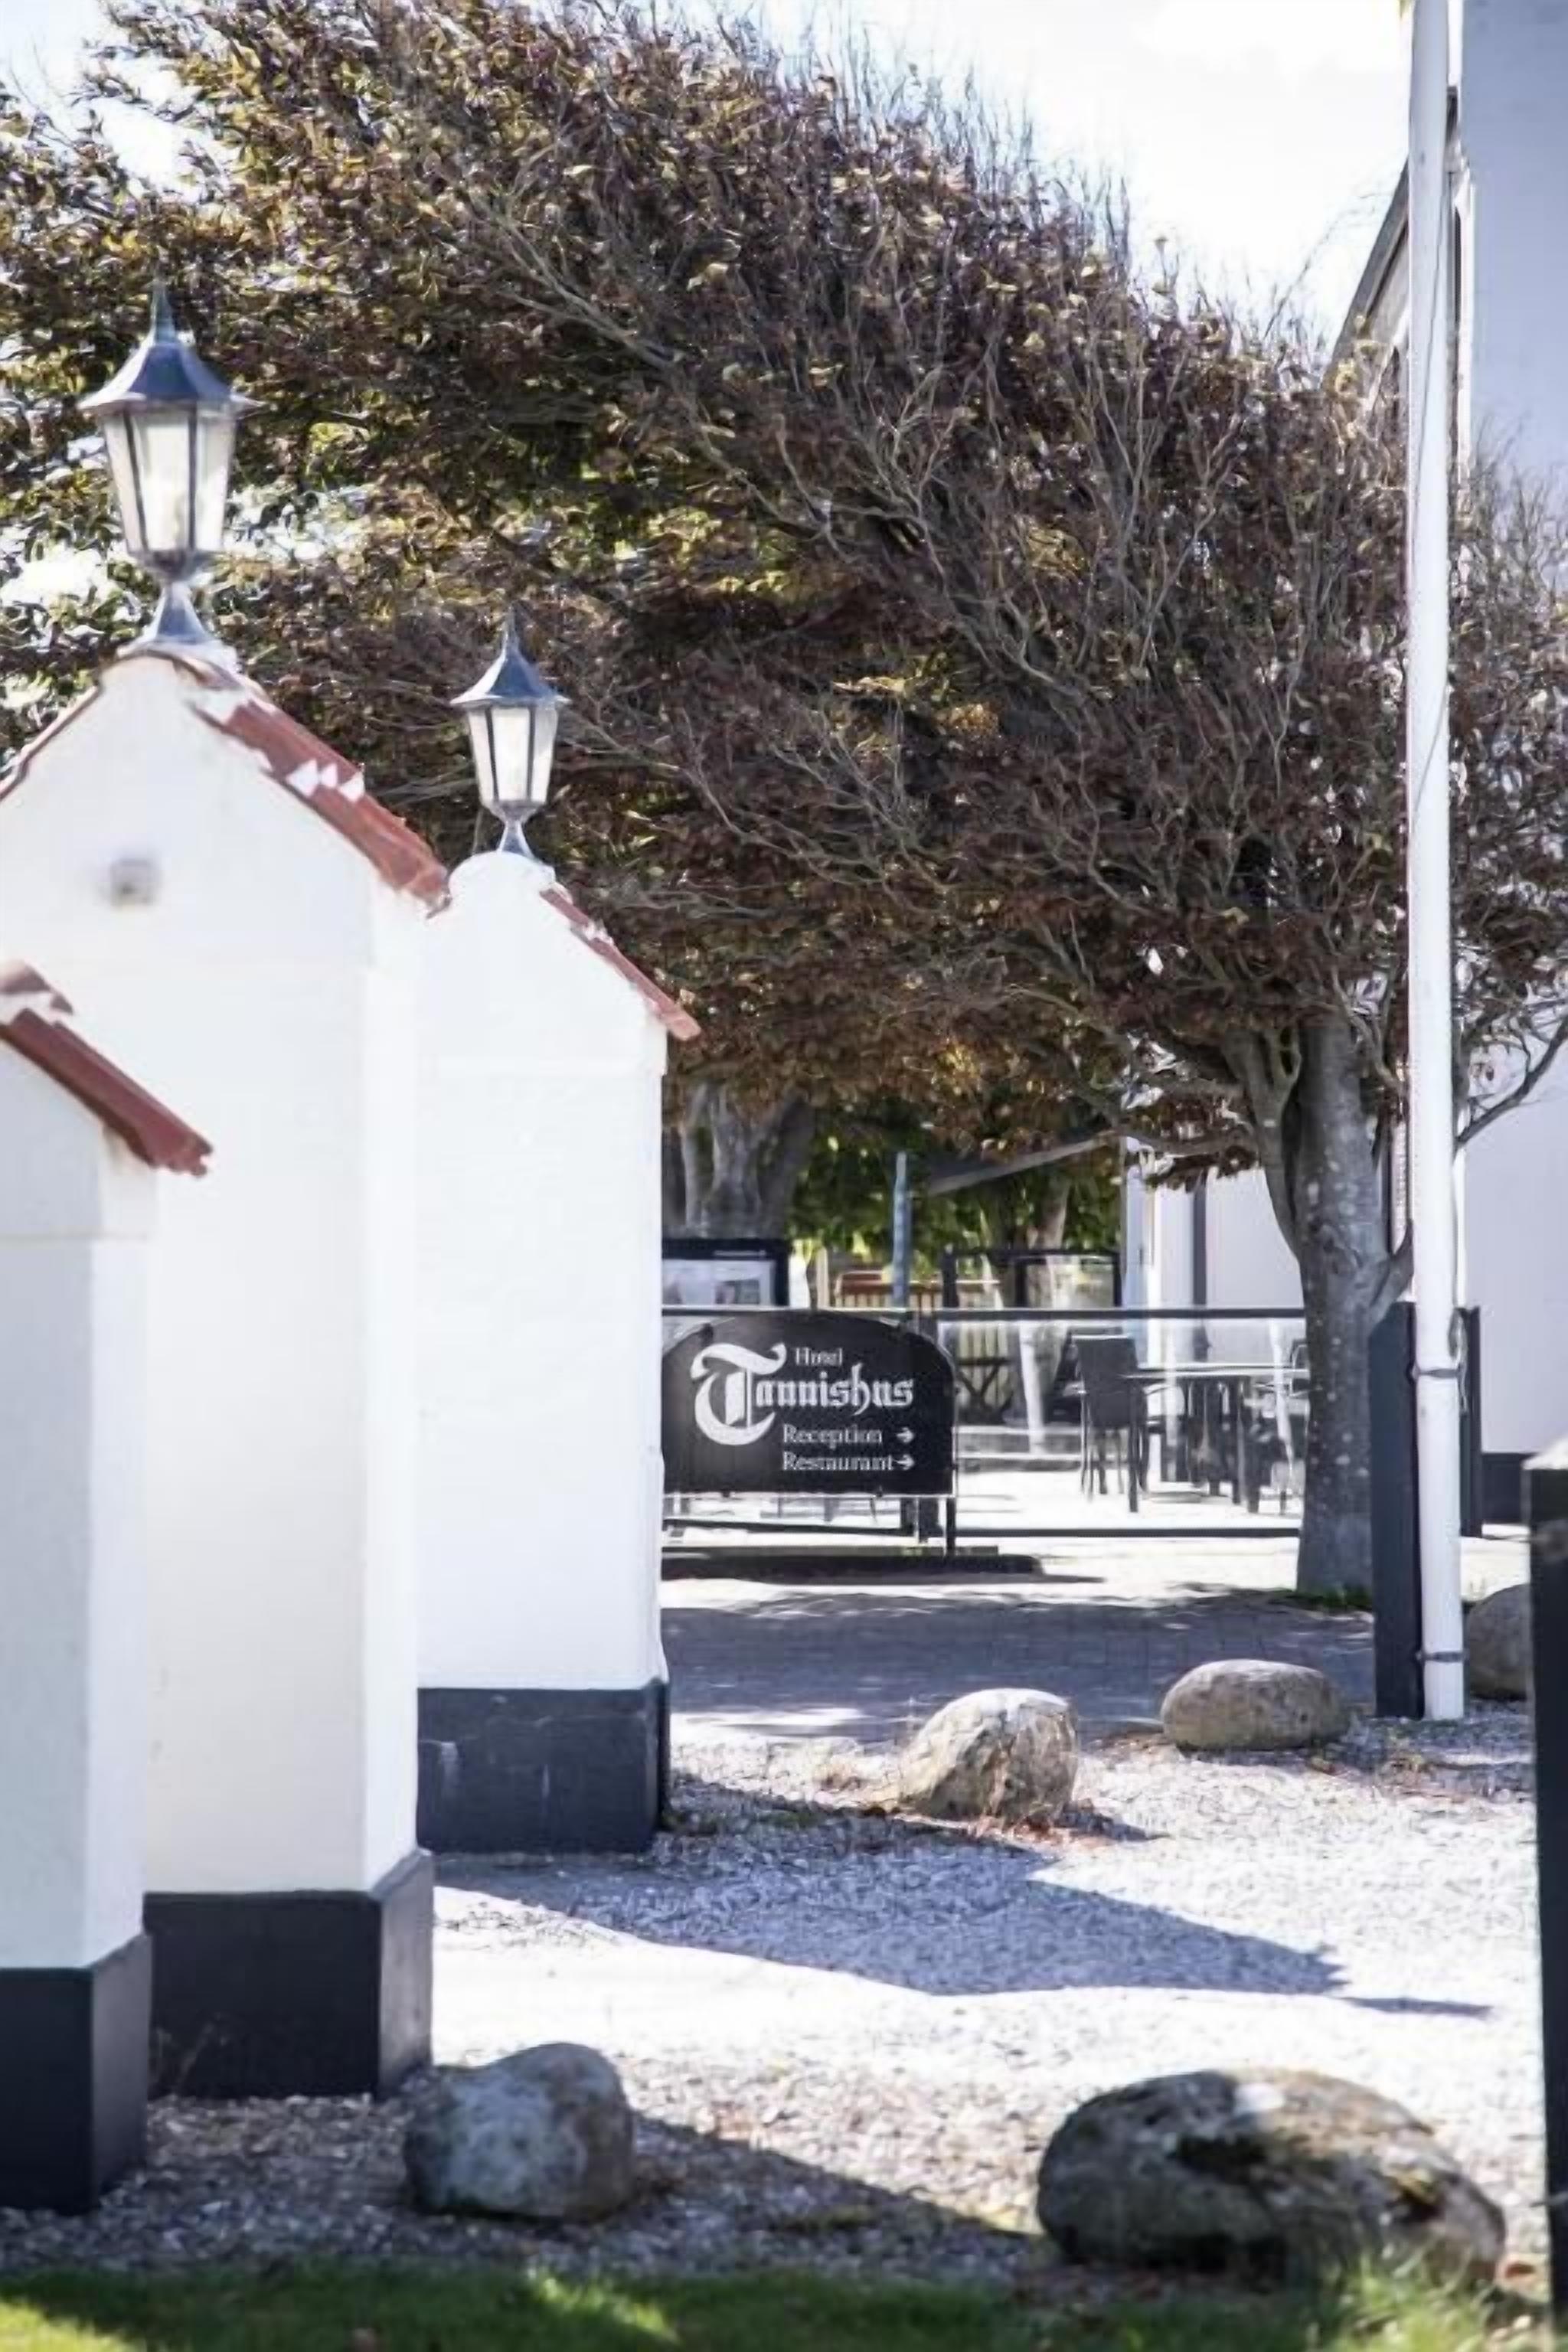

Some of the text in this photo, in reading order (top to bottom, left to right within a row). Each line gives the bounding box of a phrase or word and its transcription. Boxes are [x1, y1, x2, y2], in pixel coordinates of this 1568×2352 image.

[691, 1343, 913, 1446] Tannishus
[783, 1424, 882, 1449] Reception
[783, 1452, 893, 1470] Restaurant
